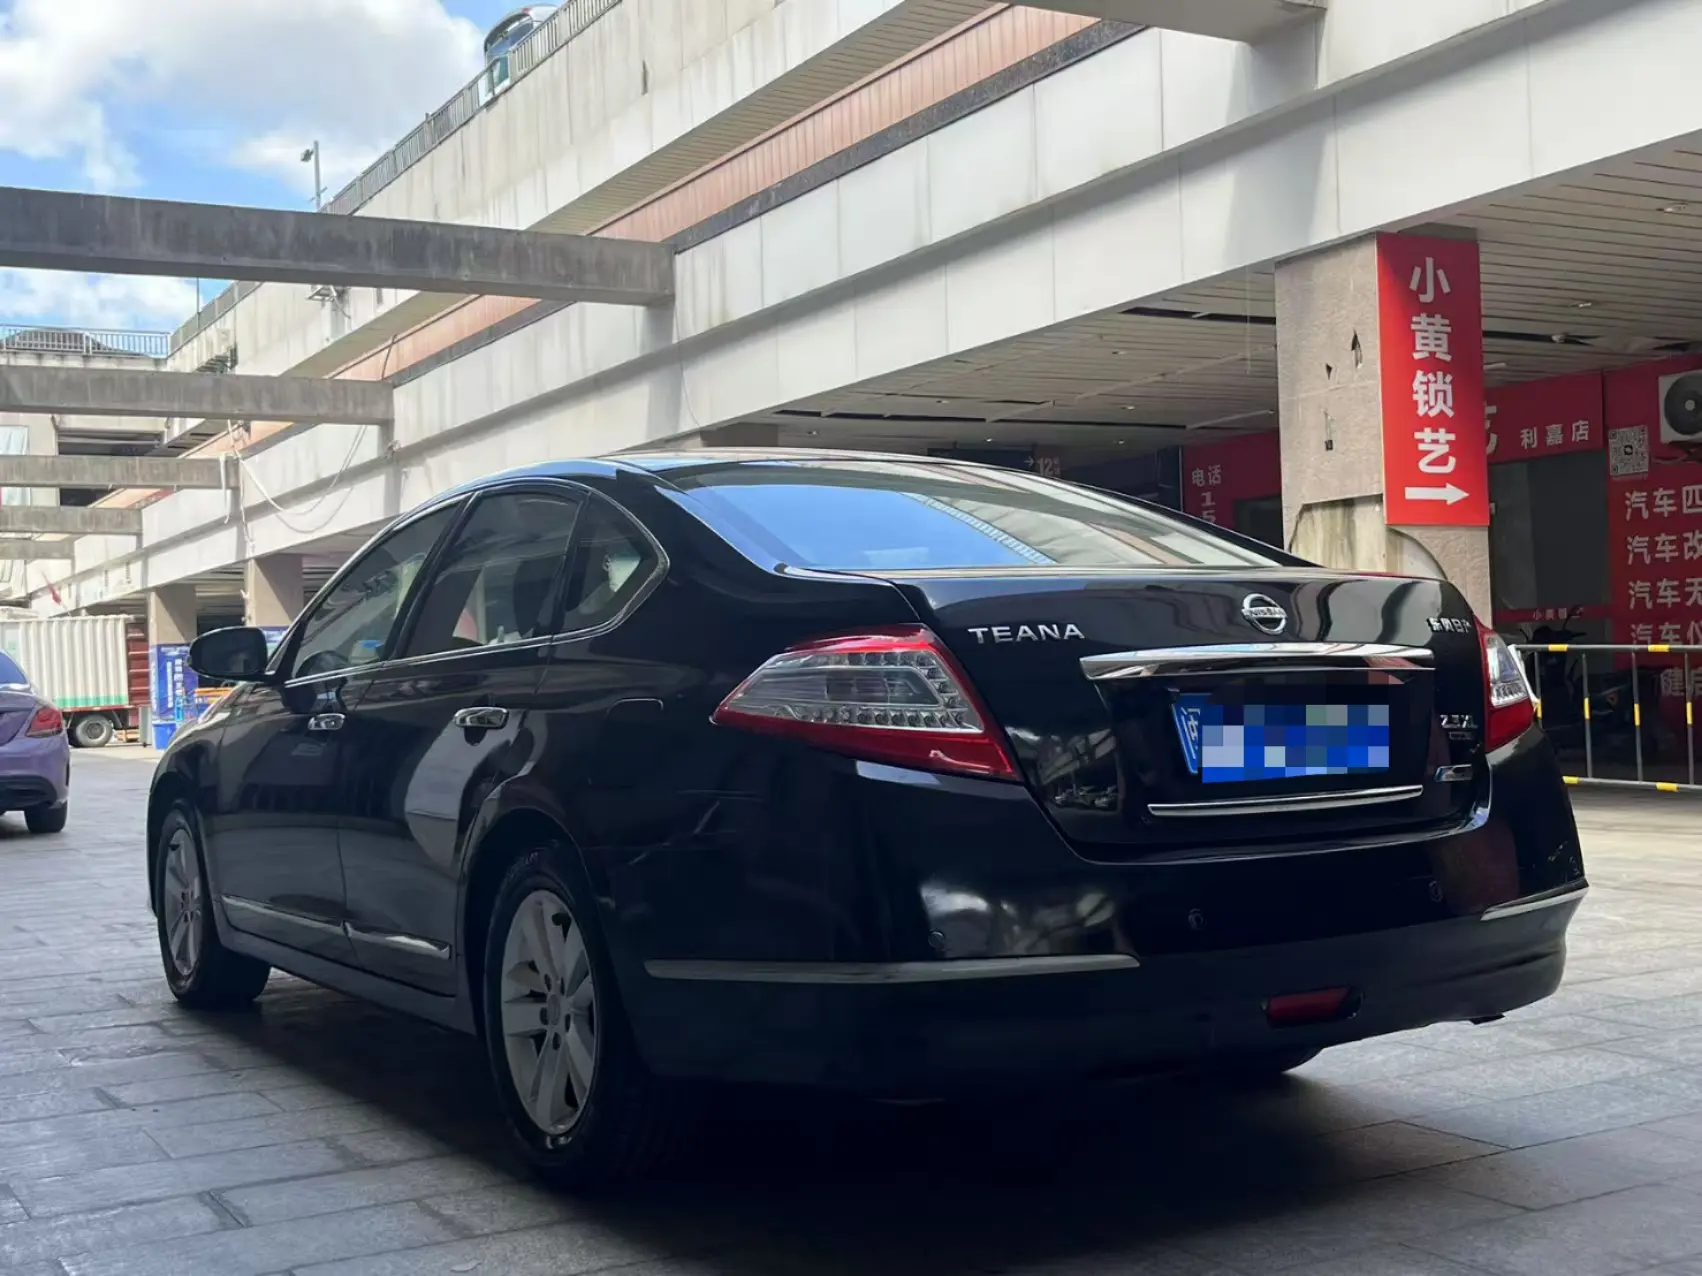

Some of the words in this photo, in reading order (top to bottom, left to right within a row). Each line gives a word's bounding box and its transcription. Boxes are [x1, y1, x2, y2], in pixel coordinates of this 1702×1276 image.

[1409, 256, 1457, 475] 小黄锁艺
[1520, 420, 1590, 449] 利嘉店
[1192, 464, 1221, 487] 电话
[967, 624, 1085, 644] TEANA
